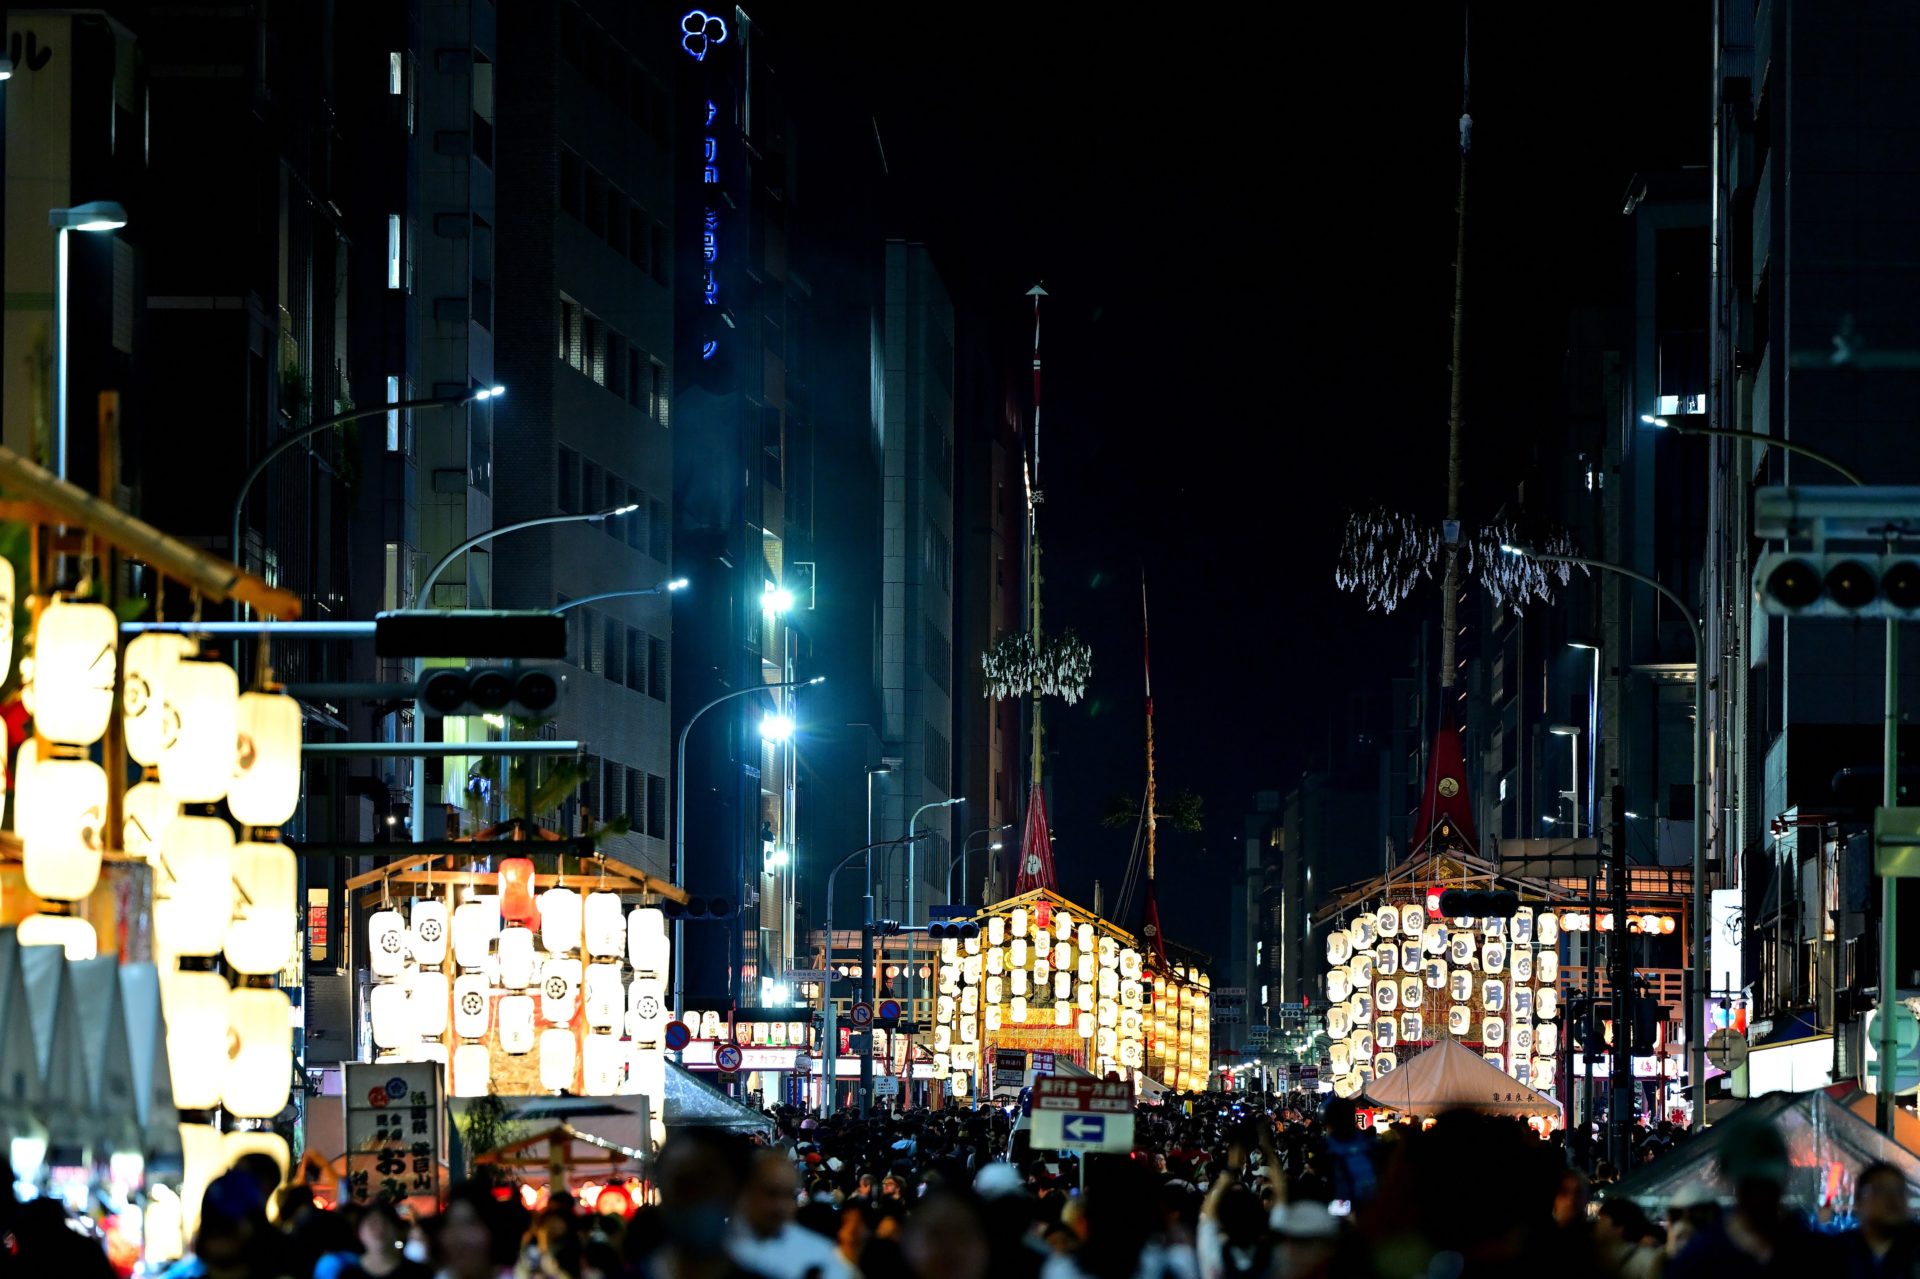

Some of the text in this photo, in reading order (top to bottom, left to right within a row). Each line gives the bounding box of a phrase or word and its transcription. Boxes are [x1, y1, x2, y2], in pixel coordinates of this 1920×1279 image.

[11, 30, 52, 72] ル
[1516, 918, 1532, 942] 月
[1377, 949, 1395, 973] 月
[1404, 946, 1421, 970] 月
[1485, 985, 1502, 1009] 月
[1515, 992, 1531, 1016] 月
[1376, 1021, 1394, 1046] 月
[1402, 1017, 1420, 1040] 月
